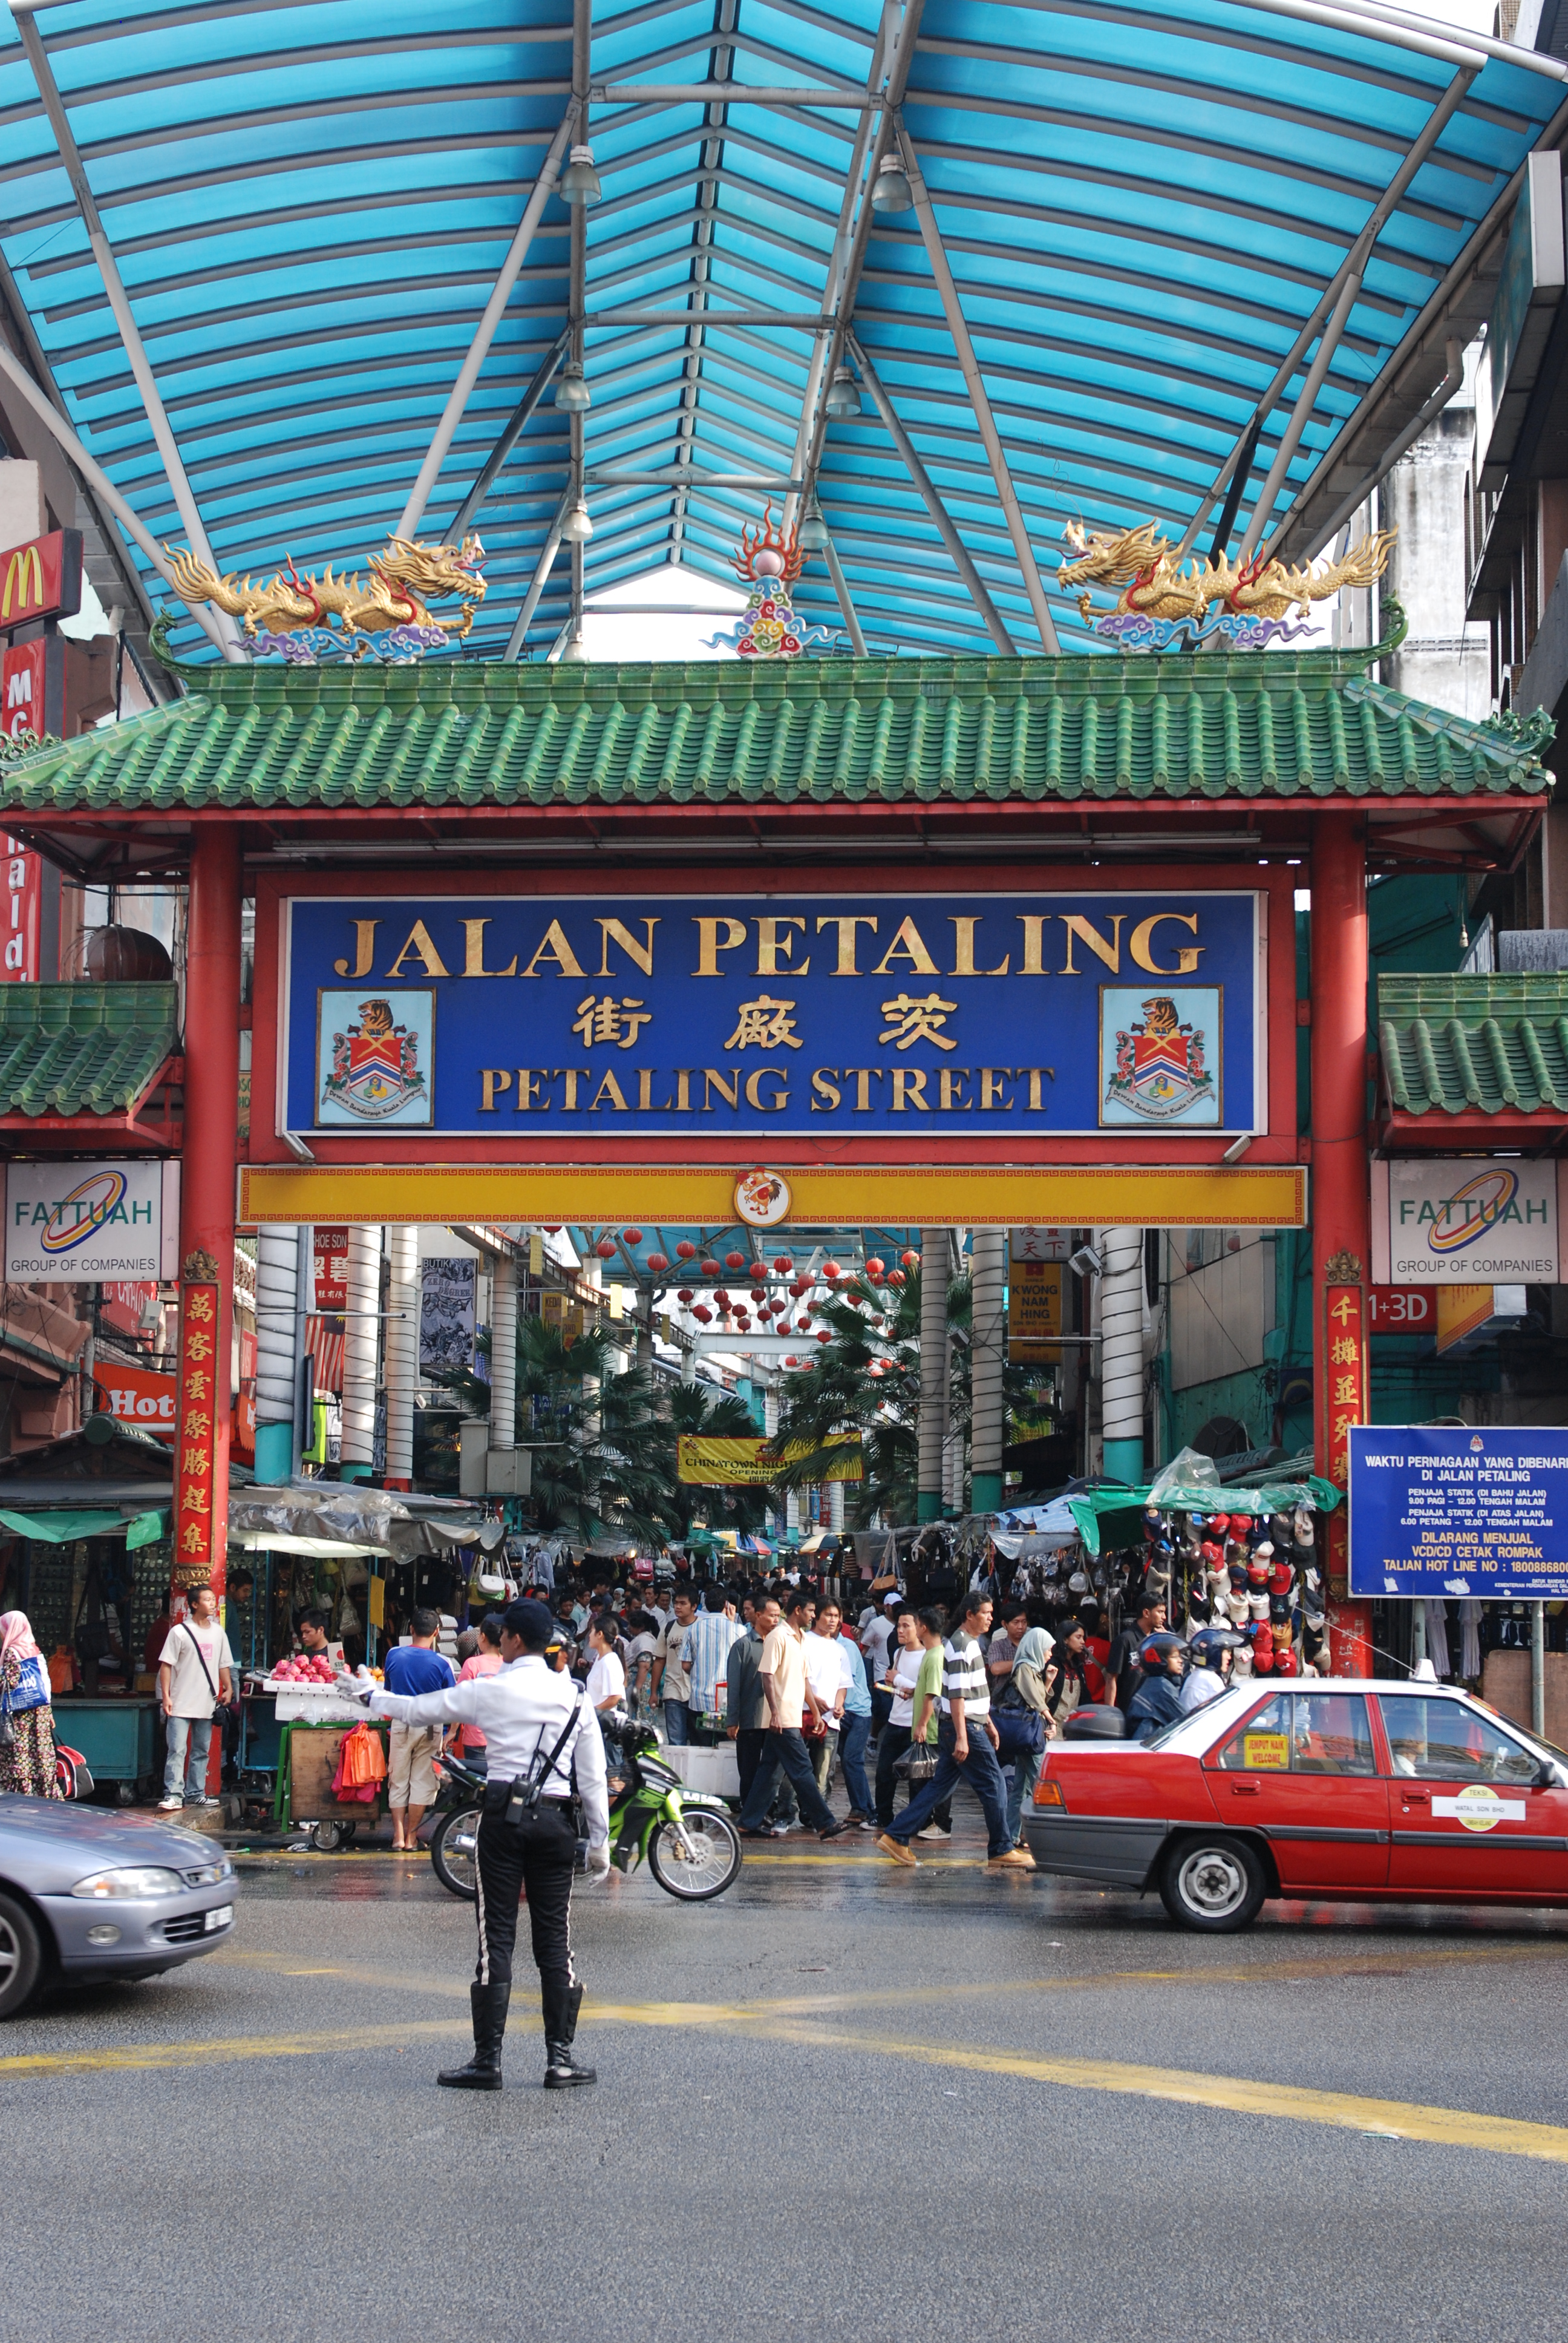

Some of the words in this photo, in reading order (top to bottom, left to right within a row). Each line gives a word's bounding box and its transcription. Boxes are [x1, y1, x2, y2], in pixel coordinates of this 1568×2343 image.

[333, 917, 662, 978] JALAN
[691, 913, 1207, 977] PETALING
[478, 1067, 790, 1112] PETALING
[811, 1067, 1054, 1112] STREET
[329, 1090, 348, 1105] Dewan
[383, 1103, 399, 1113] Kuala
[399, 1087, 422, 1104] Lumpur
[1113, 1089, 1135, 1105] Dewan
[1134, 1102, 1168, 1117] Bandaraya
[1169, 1103, 1187, 1113] Kuala
[1186, 1086, 1210, 1104] Lumpur
[15, 1200, 152, 1226] FATTUAH
[1400, 1199, 1547, 1225] FATTUAH
[314, 1234, 330, 1248] HOE
[11, 1259, 57, 1272] GROUP
[60, 1259, 77, 1271] OF
[81, 1258, 155, 1271] COMPANIES
[423, 1259, 450, 1268] BUTIK
[1397, 1260, 1446, 1273] GROUP
[1450, 1260, 1468, 1272] OF
[1472, 1259, 1553, 1272] COMPANIES
[427, 1277, 451, 1287] ZERO
[438, 1286, 470, 1297] DEGREE
[1012, 1285, 1058, 1295] KWONG
[1022, 1297, 1048, 1306] NAM
[1021, 1309, 1050, 1319] HING
[109, 1389, 175, 1417] Hot
[685, 1458, 758, 1469] CHINATOWN
[1365, 1455, 1404, 1467] WAKTU
[1408, 1456, 1479, 1468] PERNIAGAAN
[1484, 1457, 1514, 1469] YANG
[1518, 1457, 1568, 1469] DIBENAR
[1422, 1470, 1432, 1481] DI
[1437, 1470, 1474, 1481] JALAN
[1478, 1470, 1530, 1482] PETALING
[1408, 1488, 1444, 1496] PENJAJA
[1477, 1489, 1489, 1498] (DI
[1517, 1489, 1547, 1498] JALAN)
[1408, 1509, 1444, 1517] PENJAJA
[1477, 1509, 1489, 1518] (DI
[1514, 1509, 1544, 1518] JALAN)
[1422, 1532, 1478, 1544] DILARANG
[1483, 1532, 1534, 1544] MENJUAL
[1412, 1545, 1452, 1558] VCD/CD
[1457, 1546, 1493, 1558] CETAK
[1497, 1547, 1543, 1558] ROMPAK
[1383, 1559, 1422, 1571] TALIAN
[1426, 1560, 1449, 1571] HOT
[1453, 1560, 1477, 1571] LINE
[1481, 1560, 1498, 1572] NO
[1248, 1740, 1269, 1750] JEMPUT
[1270, 1740, 1284, 1751] NAIK
[1252, 1753, 1281, 1764] WELCOME
